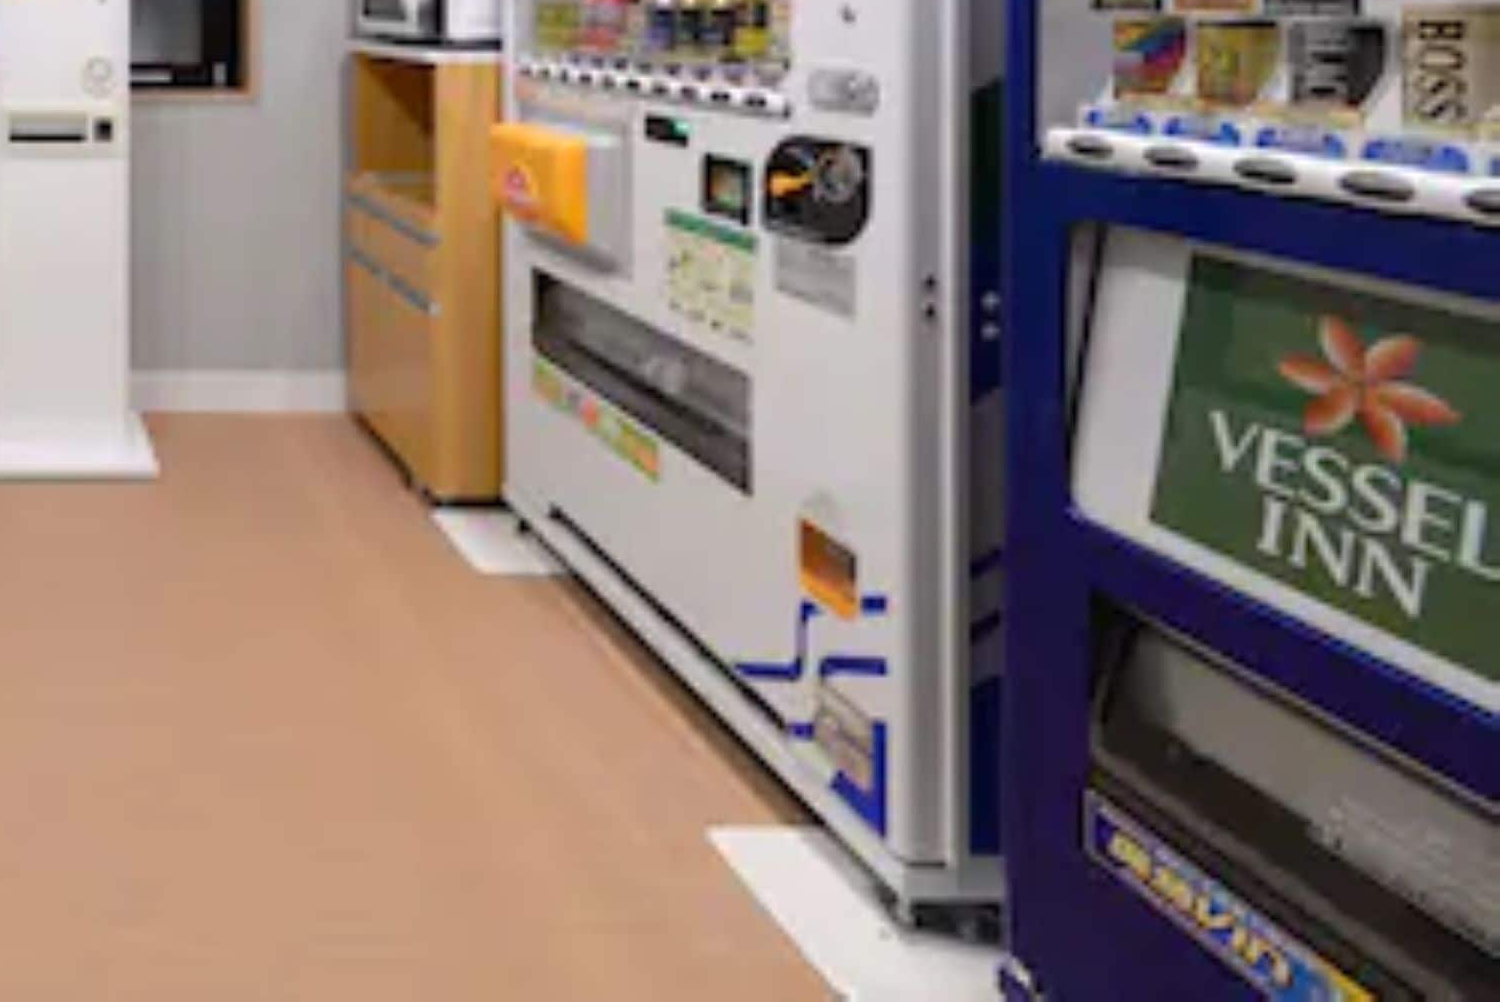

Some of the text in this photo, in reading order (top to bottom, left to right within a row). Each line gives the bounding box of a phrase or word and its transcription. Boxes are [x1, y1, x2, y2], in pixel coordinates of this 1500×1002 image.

[1417, 19, 1466, 120] BOSS
[1208, 409, 1500, 582] VESSEL
[1255, 496, 1433, 619] INN
